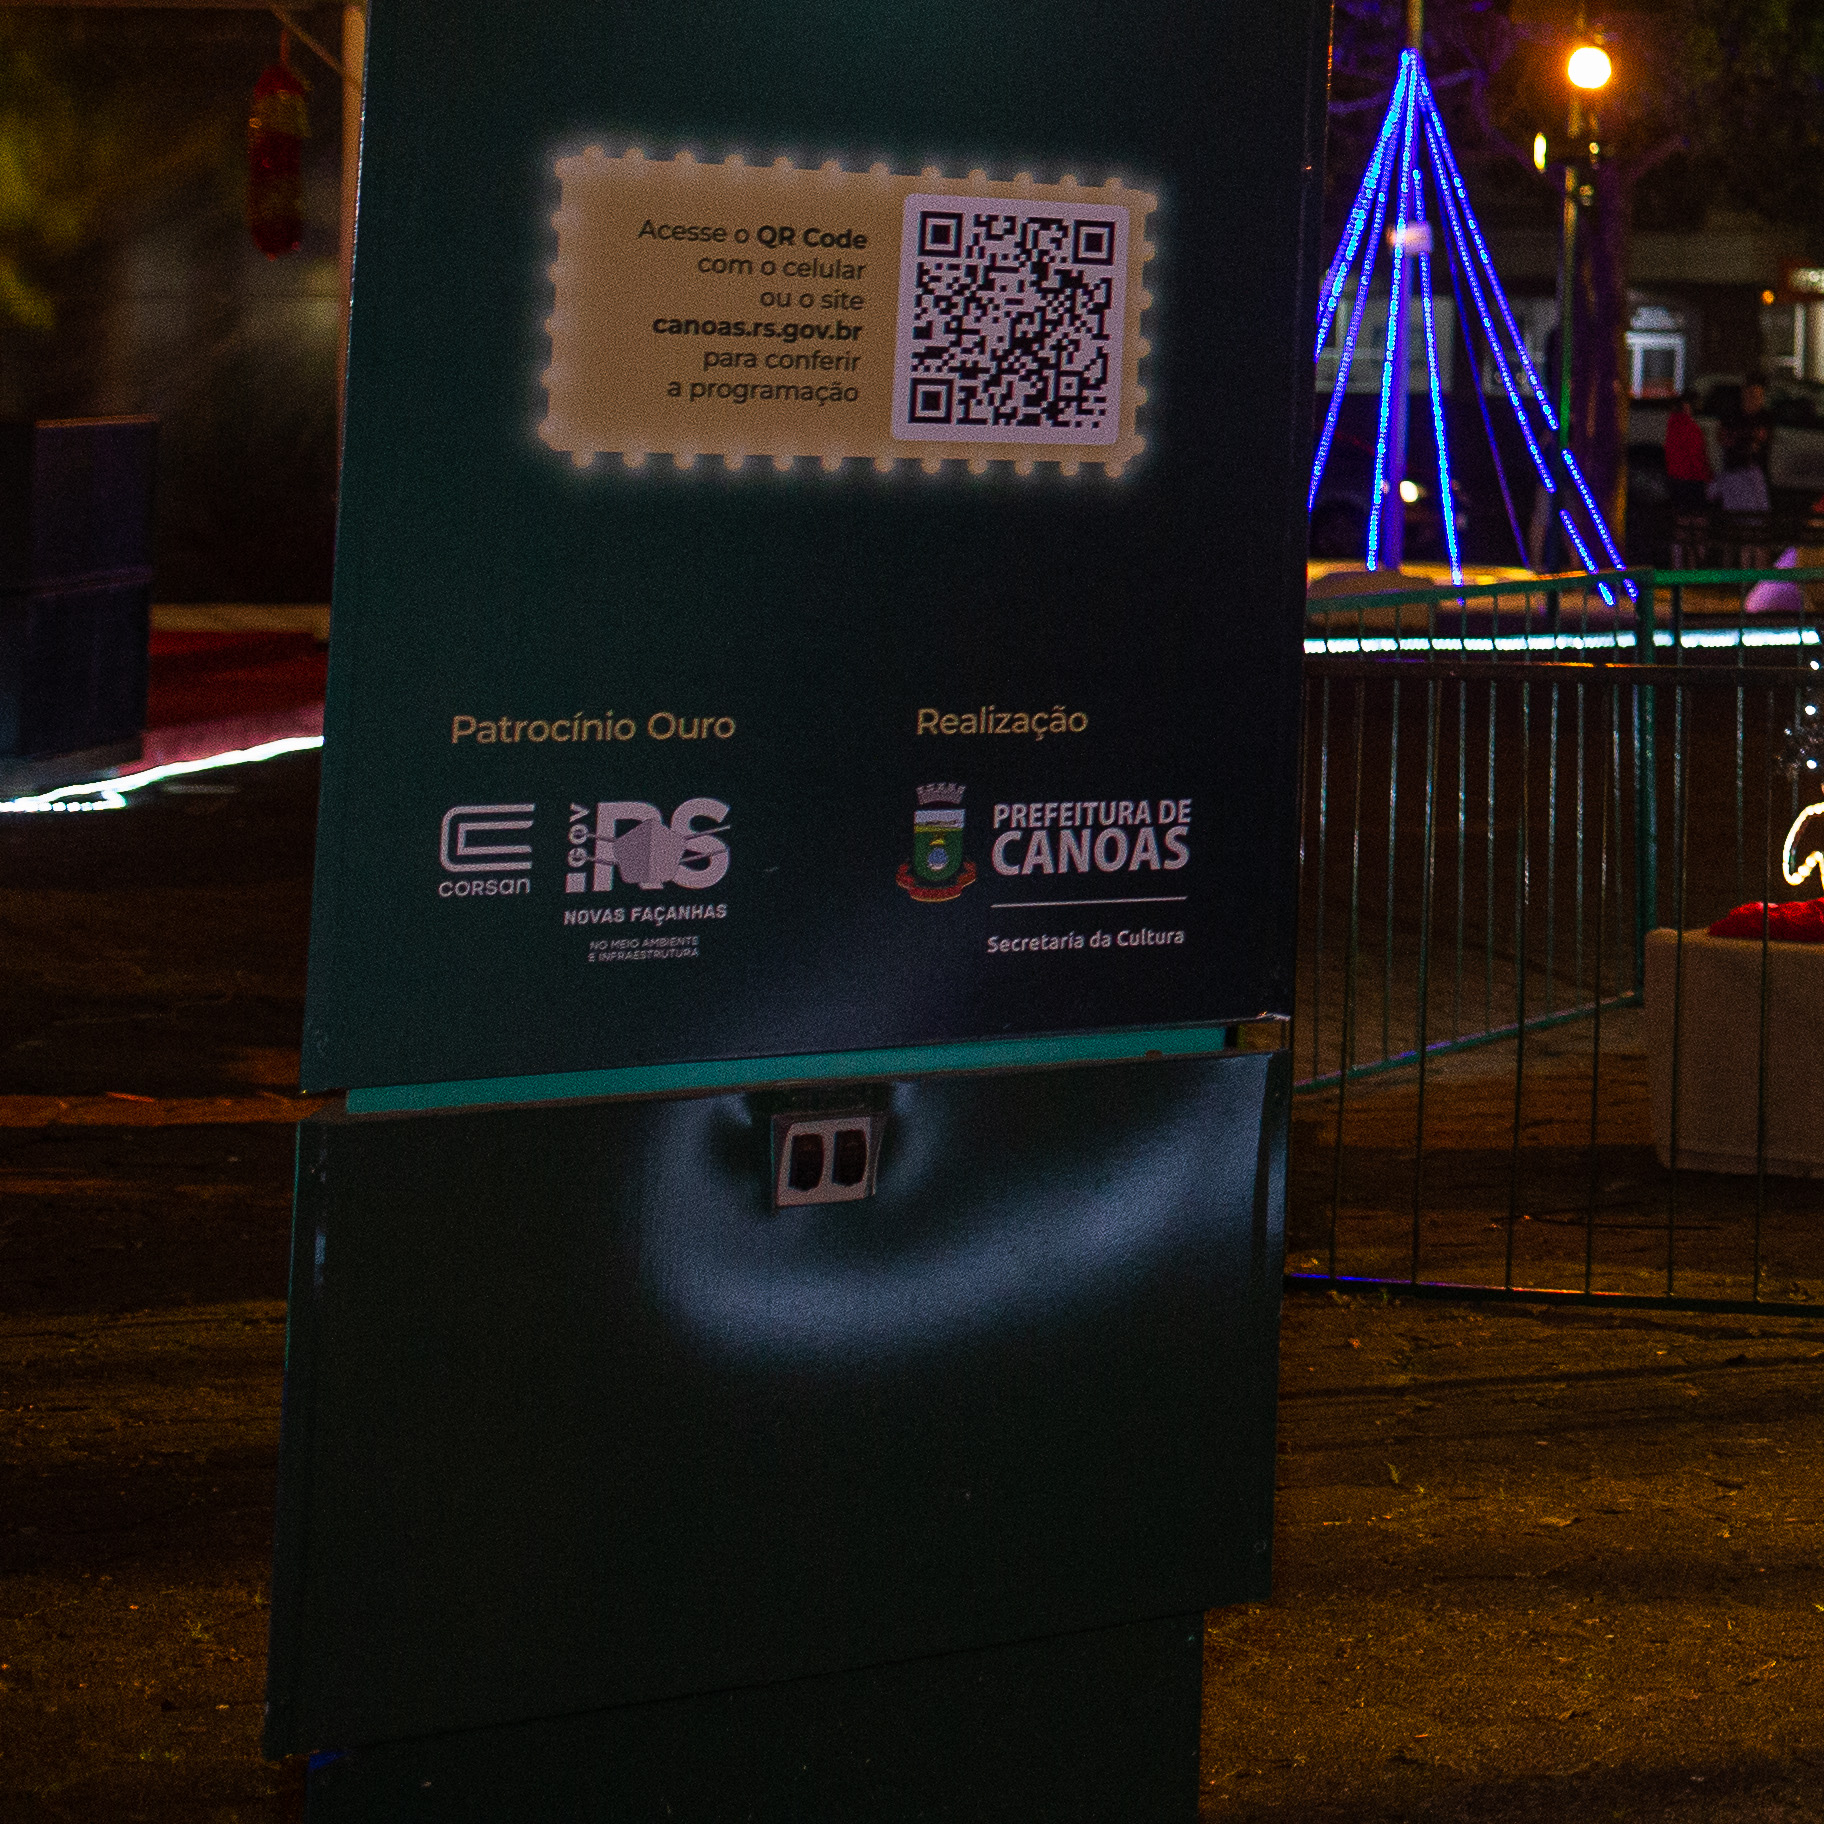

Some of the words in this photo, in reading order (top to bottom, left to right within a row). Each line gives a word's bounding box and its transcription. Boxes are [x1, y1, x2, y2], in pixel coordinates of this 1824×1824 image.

[638, 219, 727, 244] Acesse
[734, 227, 750, 244] o
[756, 224, 796, 249] QR
[803, 226, 868, 250] Code
[698, 256, 753, 274] com
[760, 260, 776, 276] o
[783, 257, 866, 280] celular
[759, 291, 792, 308] ou
[799, 293, 815, 309] o
[820, 289, 865, 311] site
[652, 318, 863, 343] canoas.rs.gov.br
[703, 350, 758, 372] para
[764, 349, 861, 371] conferir
[667, 381, 682, 398] a
[689, 381, 859, 407] programação
[451, 709, 637, 744] Patrocínio
[646, 710, 737, 741] Ouro
[915, 705, 1089, 742] Realização
[992, 799, 1150, 830] PREFEITURA
[1157, 798, 1193, 824] DE
[567, 801, 592, 868] GOV
[990, 825, 1191, 877] CANOAS
[563, 906, 626, 926] NOVAS
[629, 903, 728, 927] FAÇANHAS
[589, 939, 609, 951] NO
[610, 938, 640, 950] MEIO
[641, 936, 700, 948] AMBIENTE
[986, 931, 1084, 954] Secretaria
[1089, 931, 1113, 949] da
[1116, 928, 1186, 948] Cultura
[598, 948, 700, 963] INFRAESTRUTURA
